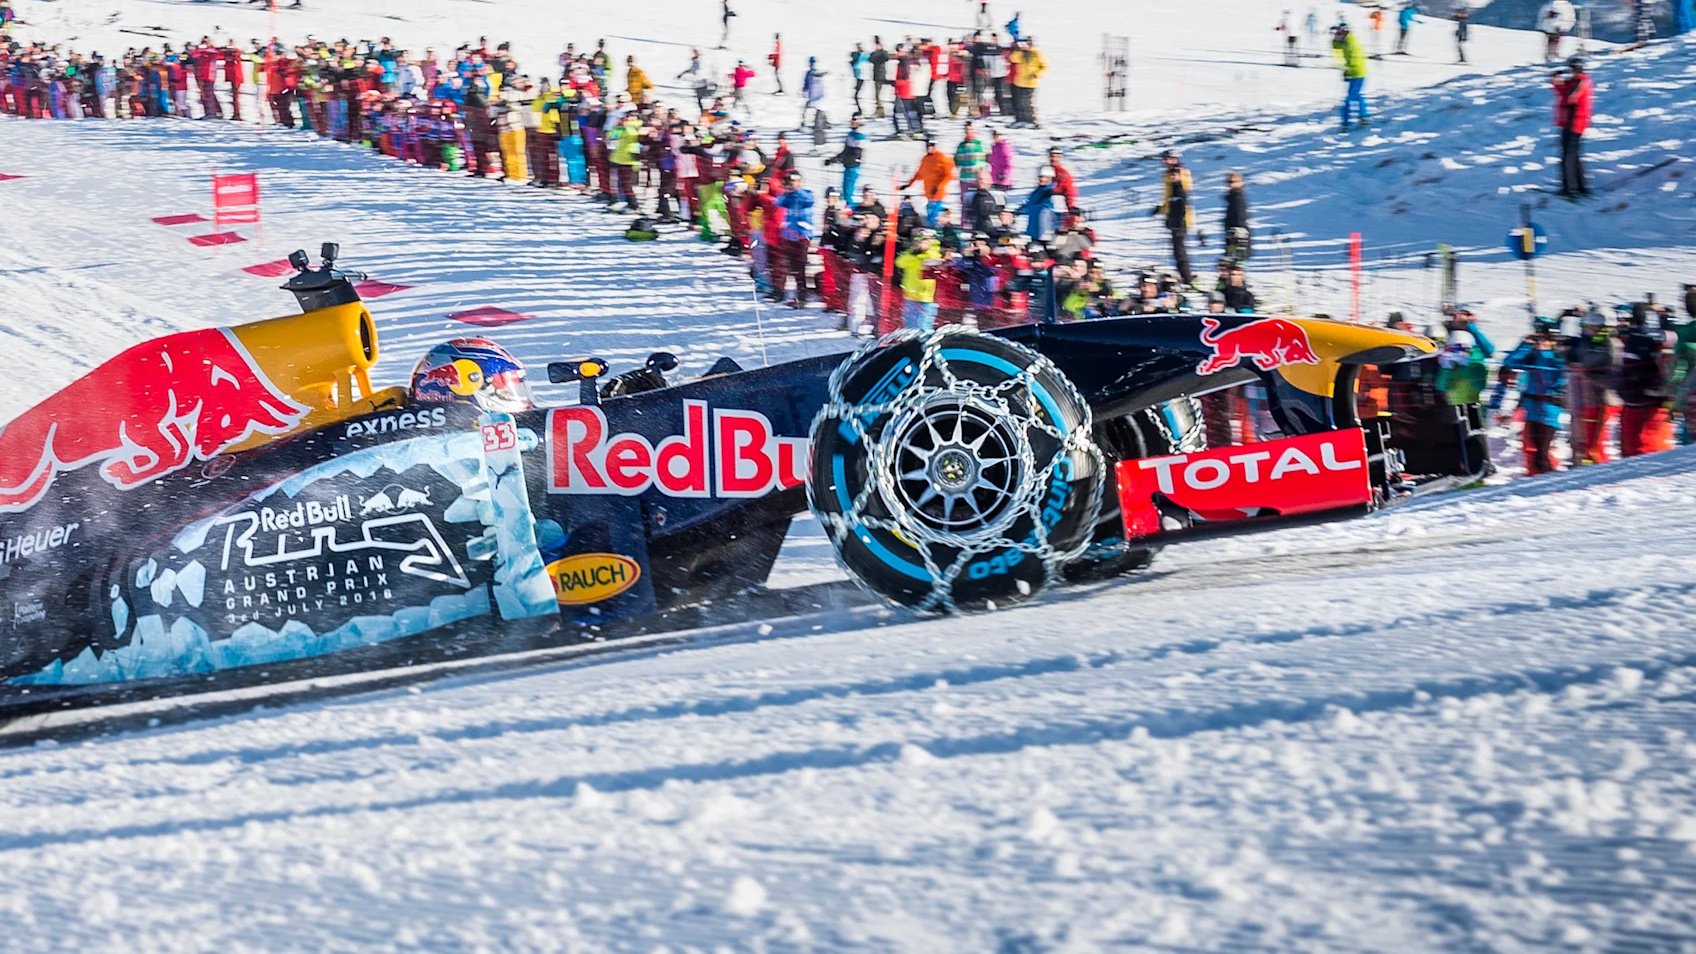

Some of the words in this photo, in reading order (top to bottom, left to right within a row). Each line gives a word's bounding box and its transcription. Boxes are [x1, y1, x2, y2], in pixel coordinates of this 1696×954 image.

[346, 407, 447, 438] exness
[482, 422, 516, 452] 33
[548, 400, 709, 495] Red
[716, 410, 812, 495] Bu
[1138, 442, 1362, 494] TOTAL
[261, 502, 305, 532] Red
[306, 495, 352, 525] Bull
[224, 555, 384, 594] AUSTRIAN
[226, 586, 307, 610] GRAND
[326, 573, 388, 595] PRIX
[559, 563, 626, 592] RAUCH
[275, 599, 324, 617] JULY
[339, 589, 393, 606] 2016
